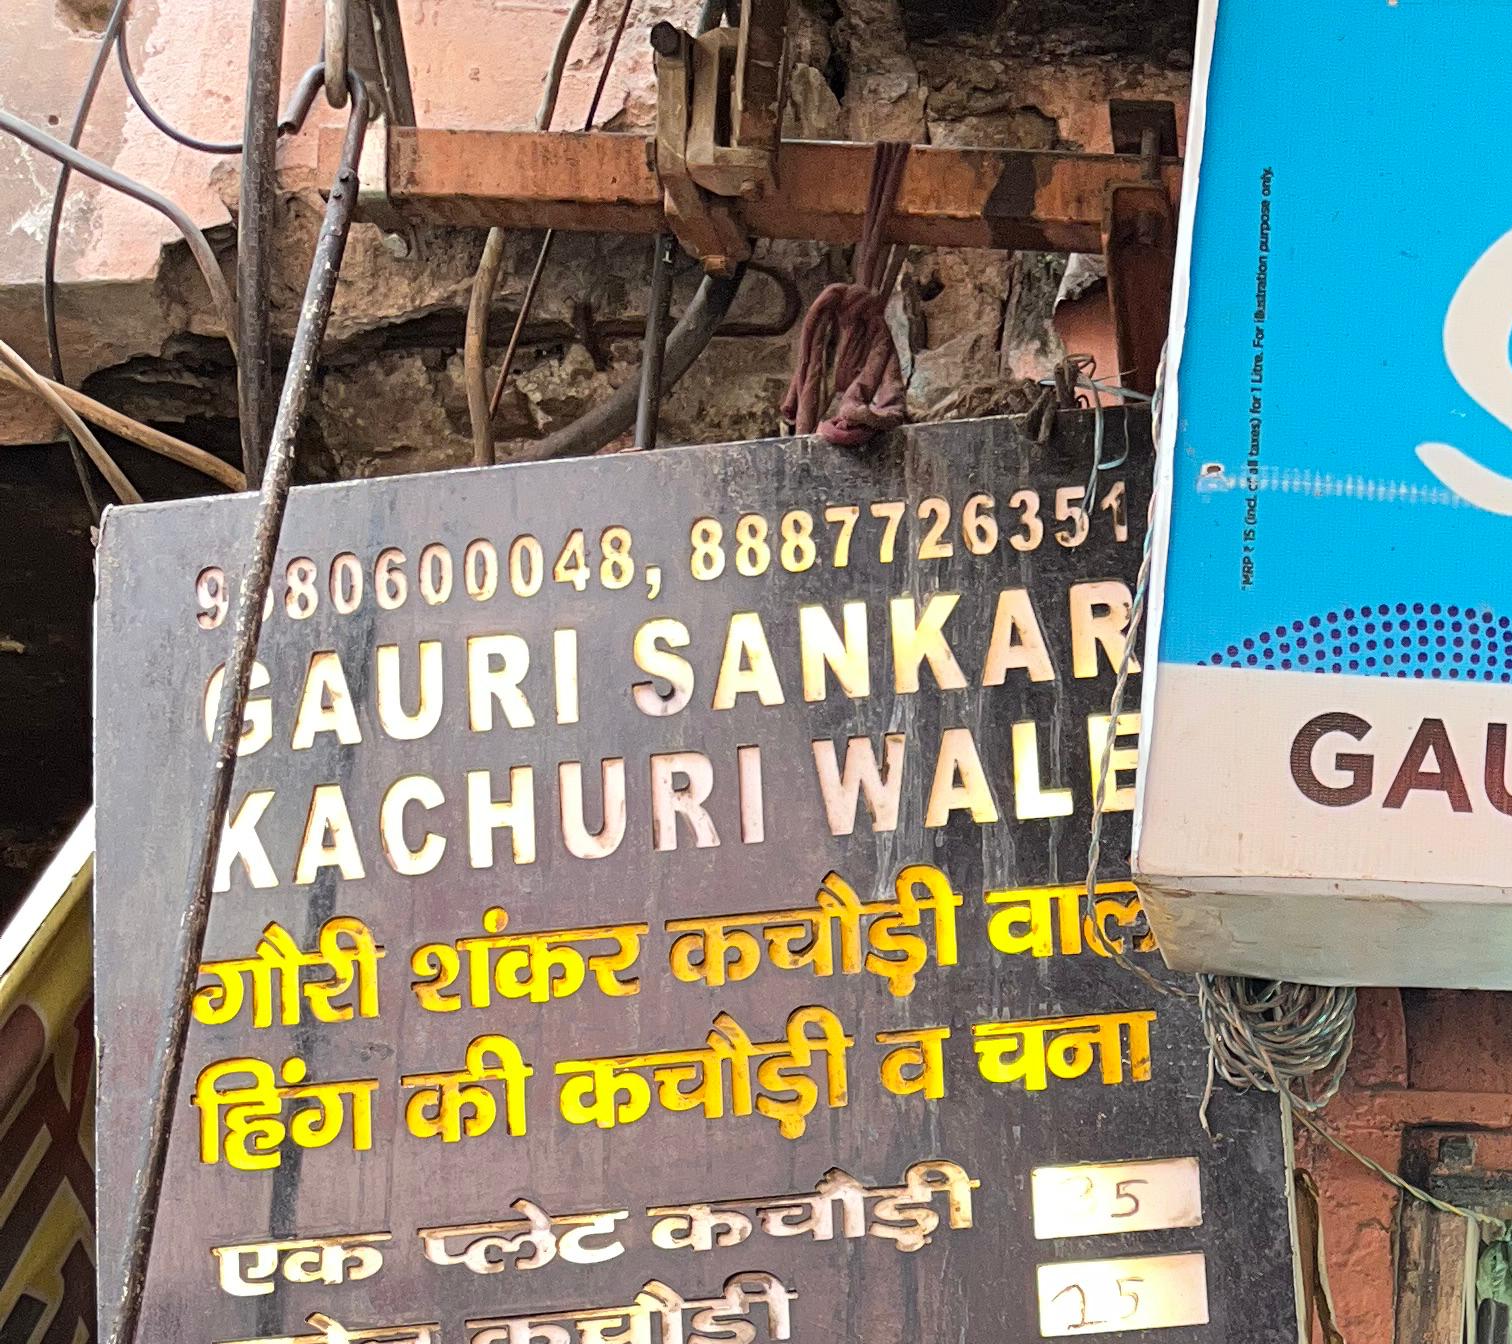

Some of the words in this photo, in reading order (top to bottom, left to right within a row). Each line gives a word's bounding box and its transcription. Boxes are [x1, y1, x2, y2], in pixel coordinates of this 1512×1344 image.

[1253, 327, 1265, 349] For
[1260, 199, 1271, 253] purpose
[205, 629, 579, 757] GAURI
[631, 579, 1142, 717] SANKAR
[211, 745, 765, 893] KACHURI
[811, 712, 1144, 836] WALE
[192, 916, 386, 1030] गौरी
[411, 907, 650, 1014] शंकर
[663, 864, 964, 998] कचौड़ी
[193, 1056, 379, 1170] हिंग
[401, 1034, 534, 1144] की
[555, 1005, 856, 1140] कचौड़ी
[875, 1029, 950, 1099] व
[972, 1010, 1157, 1092] चना
[213, 1231, 392, 1299] एक
[418, 1198, 630, 1280] प्लेट
[646, 1160, 982, 1254] कचौड़ी
